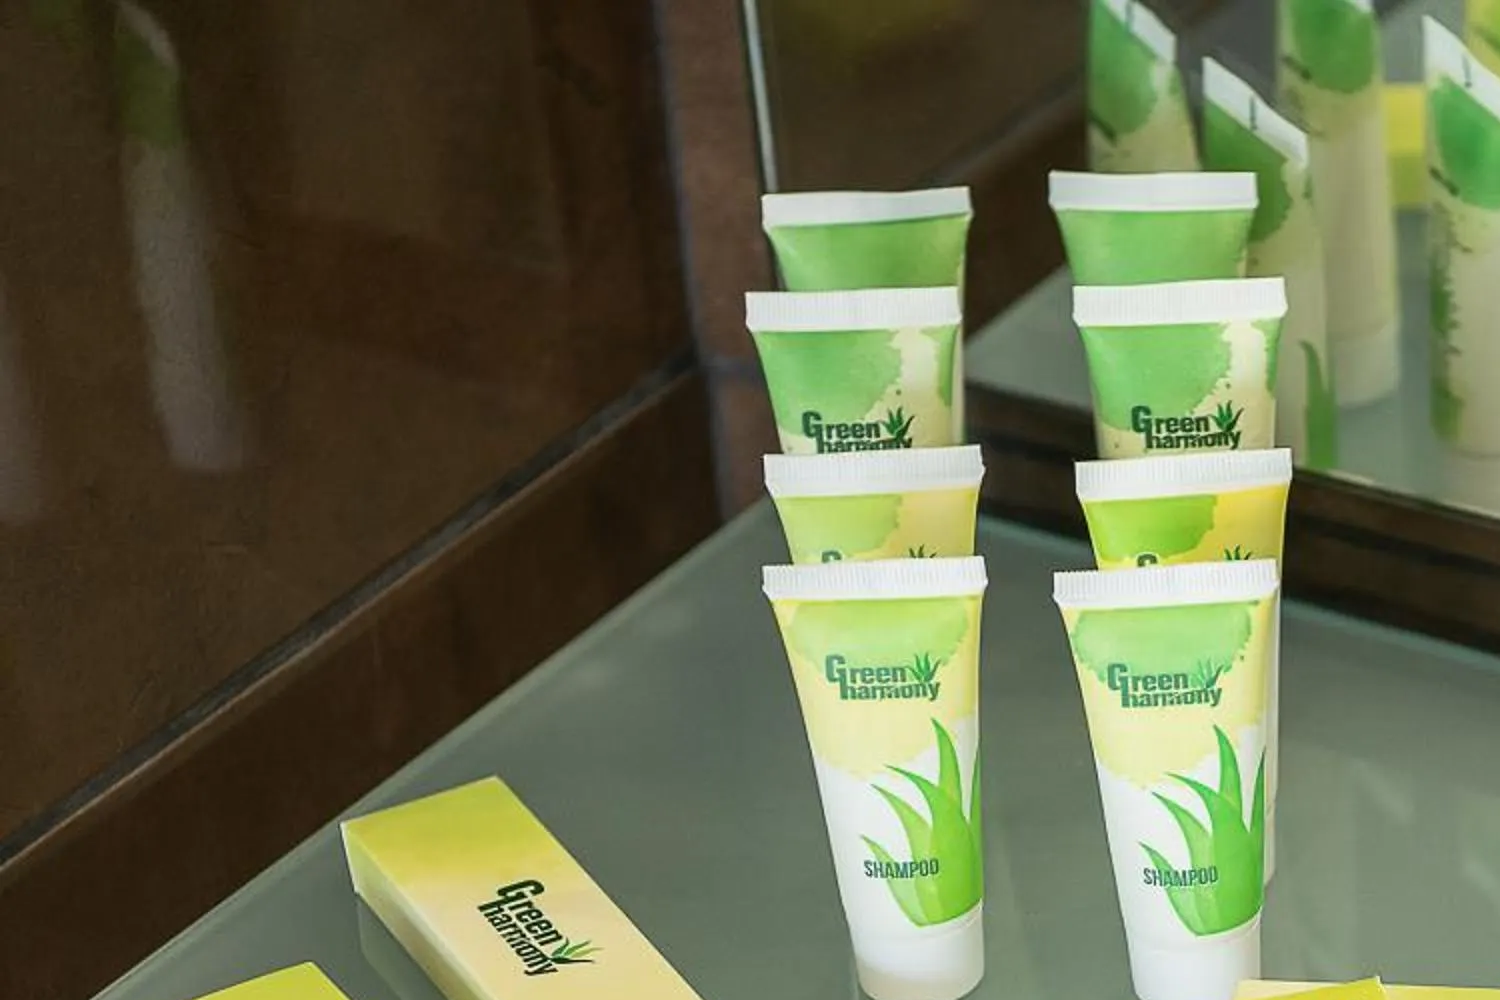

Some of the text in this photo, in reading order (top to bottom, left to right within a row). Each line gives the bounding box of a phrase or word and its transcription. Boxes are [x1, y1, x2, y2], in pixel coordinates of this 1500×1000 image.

[802, 410, 881, 439] Green
[1131, 405, 1211, 434] Green
[1145, 430, 1242, 450] harmony
[825, 654, 907, 684] Green
[1107, 662, 1189, 692] Green
[839, 681, 941, 701] harmony
[1120, 687, 1222, 708] harmony
[863, 858, 940, 878] SHAMPOO
[1143, 865, 1219, 887] SHAMPOO
[497, 879, 563, 946] Green
[477, 898, 559, 976] harmony
